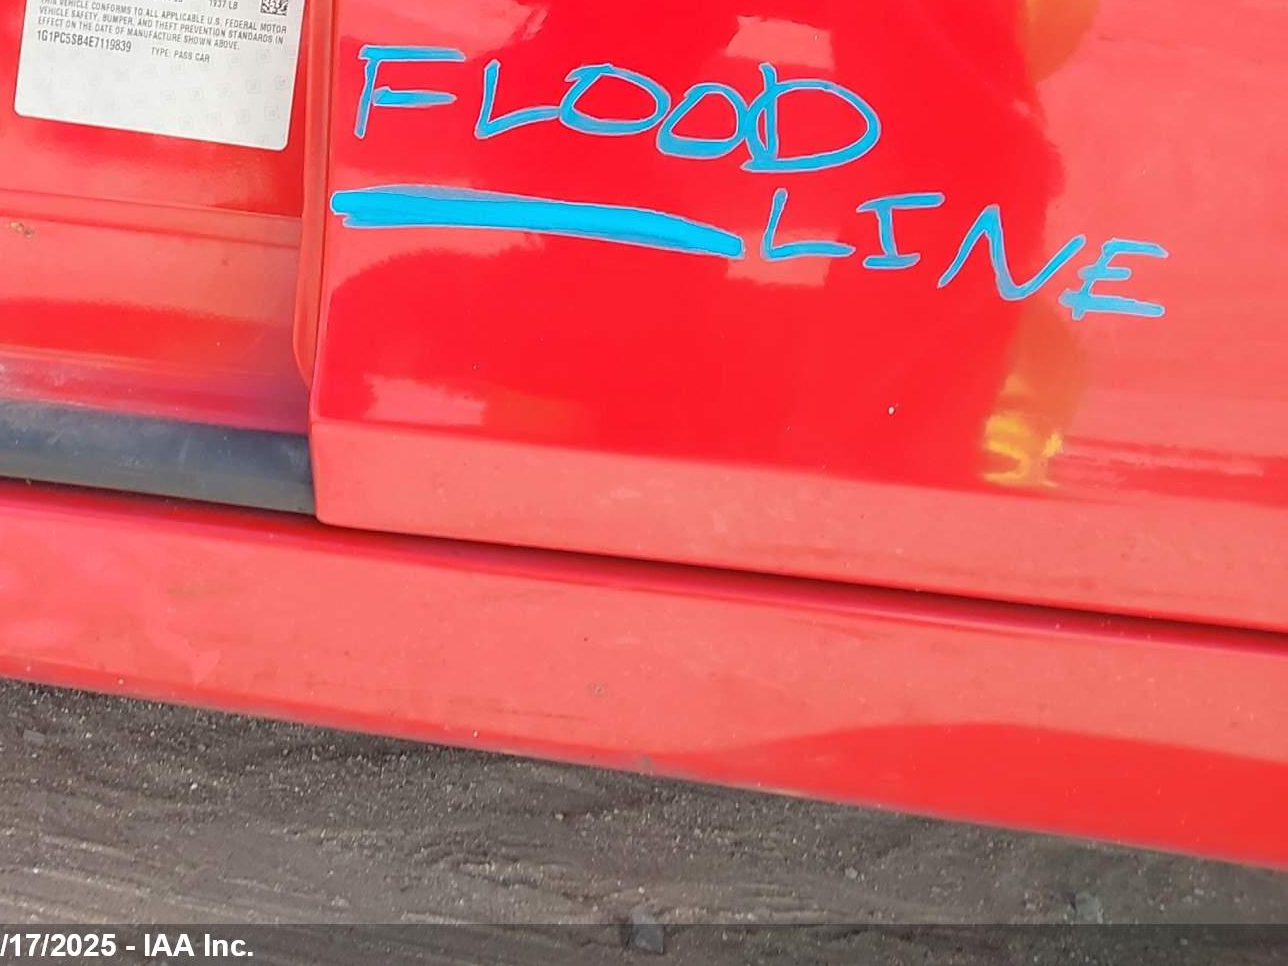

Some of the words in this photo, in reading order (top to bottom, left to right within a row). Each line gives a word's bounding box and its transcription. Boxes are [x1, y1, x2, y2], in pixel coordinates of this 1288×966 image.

[91, 1, 131, 13] CONFORMS
[134, 6, 143, 15] TO
[146, 8, 158, 18] ALL
[161, 10, 204, 23] APPLICABLE
[207, 17, 222, 26] U.S.
[225, 19, 257, 30] FEDERAL
[260, 23, 287, 34] MOTOR
[209, 0, 227, 9] 1937
[228, 1, 238, 10] LB
[38, 16, 64, 27] EFFECT
[65, 19, 76, 29] ON
[79, 21, 92, 31] THE
[95, 24, 112, 34] DATE
[115, 25, 125, 34] OF
[127, 27, 181, 43] MANUFACTURE
[184, 35, 212, 46] SHOWN
[214, 39, 240, 50] ABOVE.
[39, 6, 68, 17] VEHICLE
[137, 17, 153, 27] AND
[155, 20, 177, 30] THEFT
[180, 22, 226, 37] PREVENTION
[228, 30, 273, 43] STANDARDS
[275, 36, 284, 45] IN
[173, 50, 193, 60] PASS
[195, 53, 210, 63] CAR
[354, 44, 880, 173] FLOOD
[760, 188, 1170, 320] LINE
